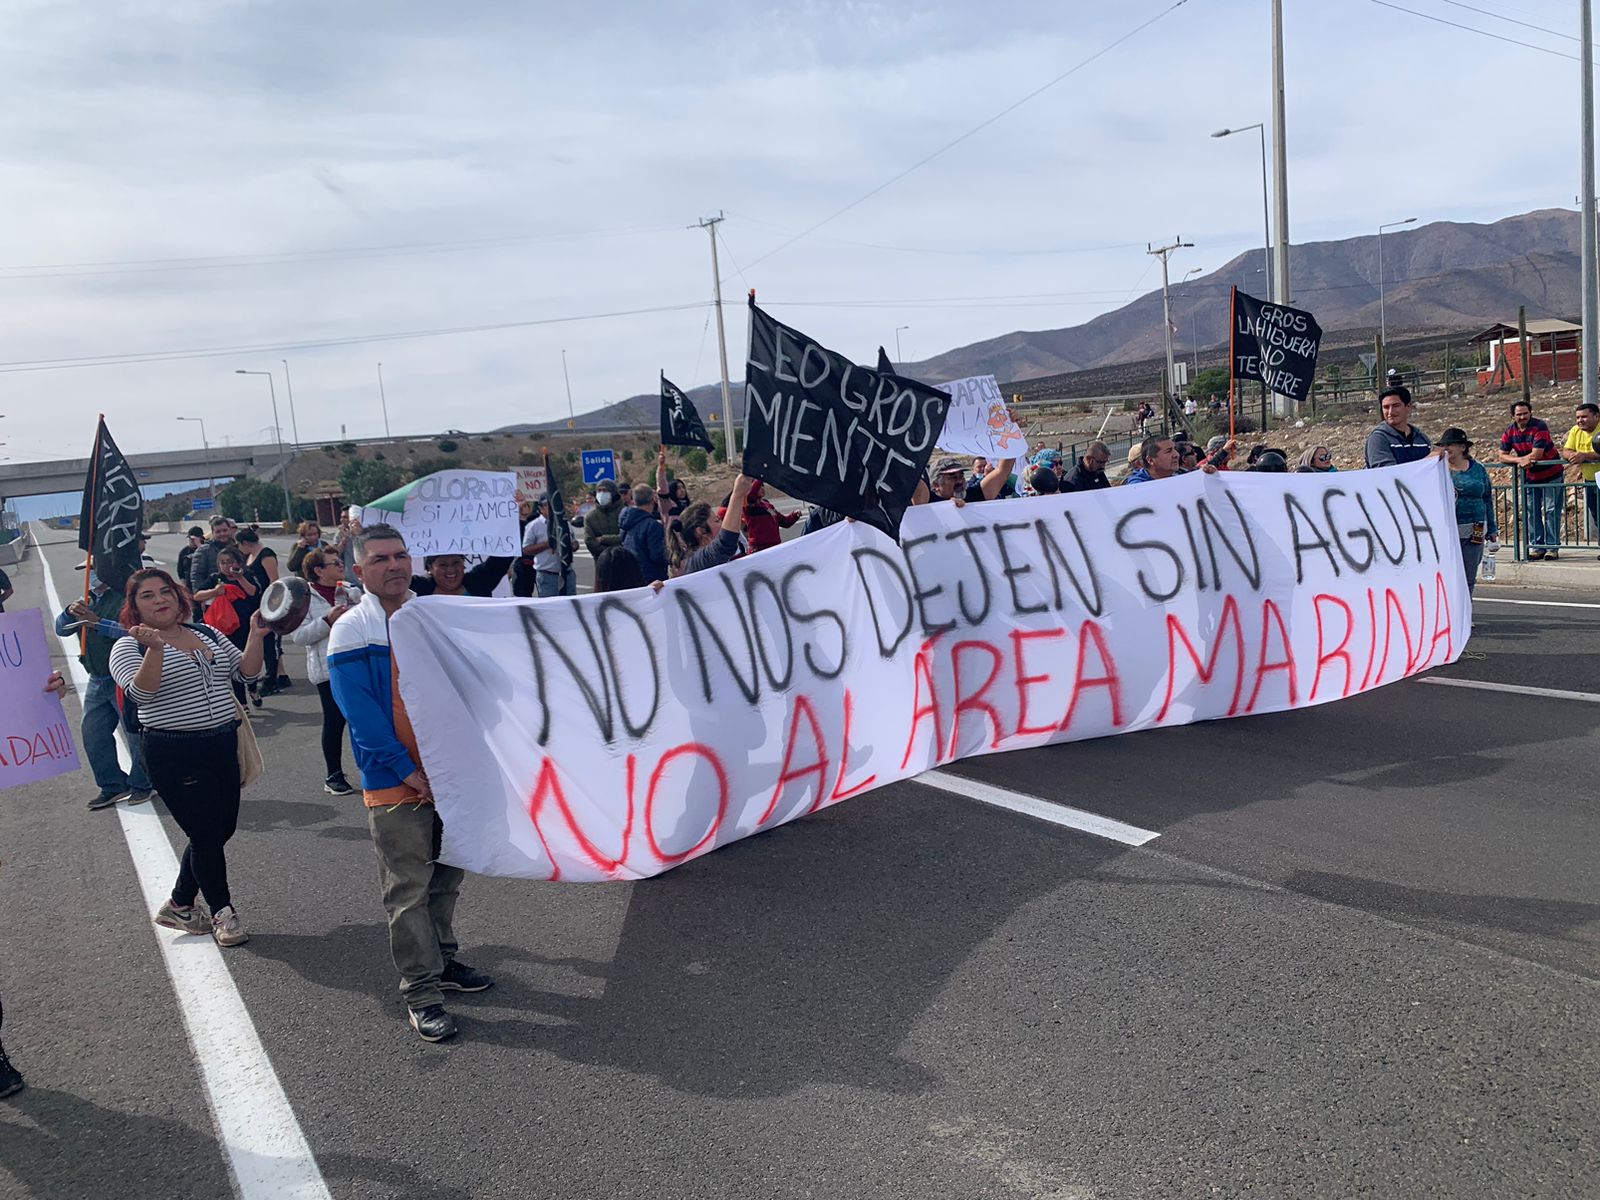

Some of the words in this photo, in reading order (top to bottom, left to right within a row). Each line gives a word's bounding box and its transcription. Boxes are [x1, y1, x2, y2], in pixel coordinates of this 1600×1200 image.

[1260, 304, 1308, 332] GROS
[1261, 344, 1285, 366] NO
[746, 310, 831, 388] LEO
[840, 364, 943, 452] GROS
[585, 456, 612, 465] Salida
[743, 383, 917, 496] MIENTE
[525, 480, 542, 490] NO
[518, 597, 659, 746] NO
[675, 564, 848, 706] NOS
[850, 510, 1102, 660] DEJEN
[1115, 489, 1260, 602] SIN
[1284, 478, 1440, 584] AGUA
[0, 723, 73, 766] DA!!!
[529, 742, 729, 881] NO
[757, 687, 877, 826] AL
[1156, 570, 1454, 724] MARINA
